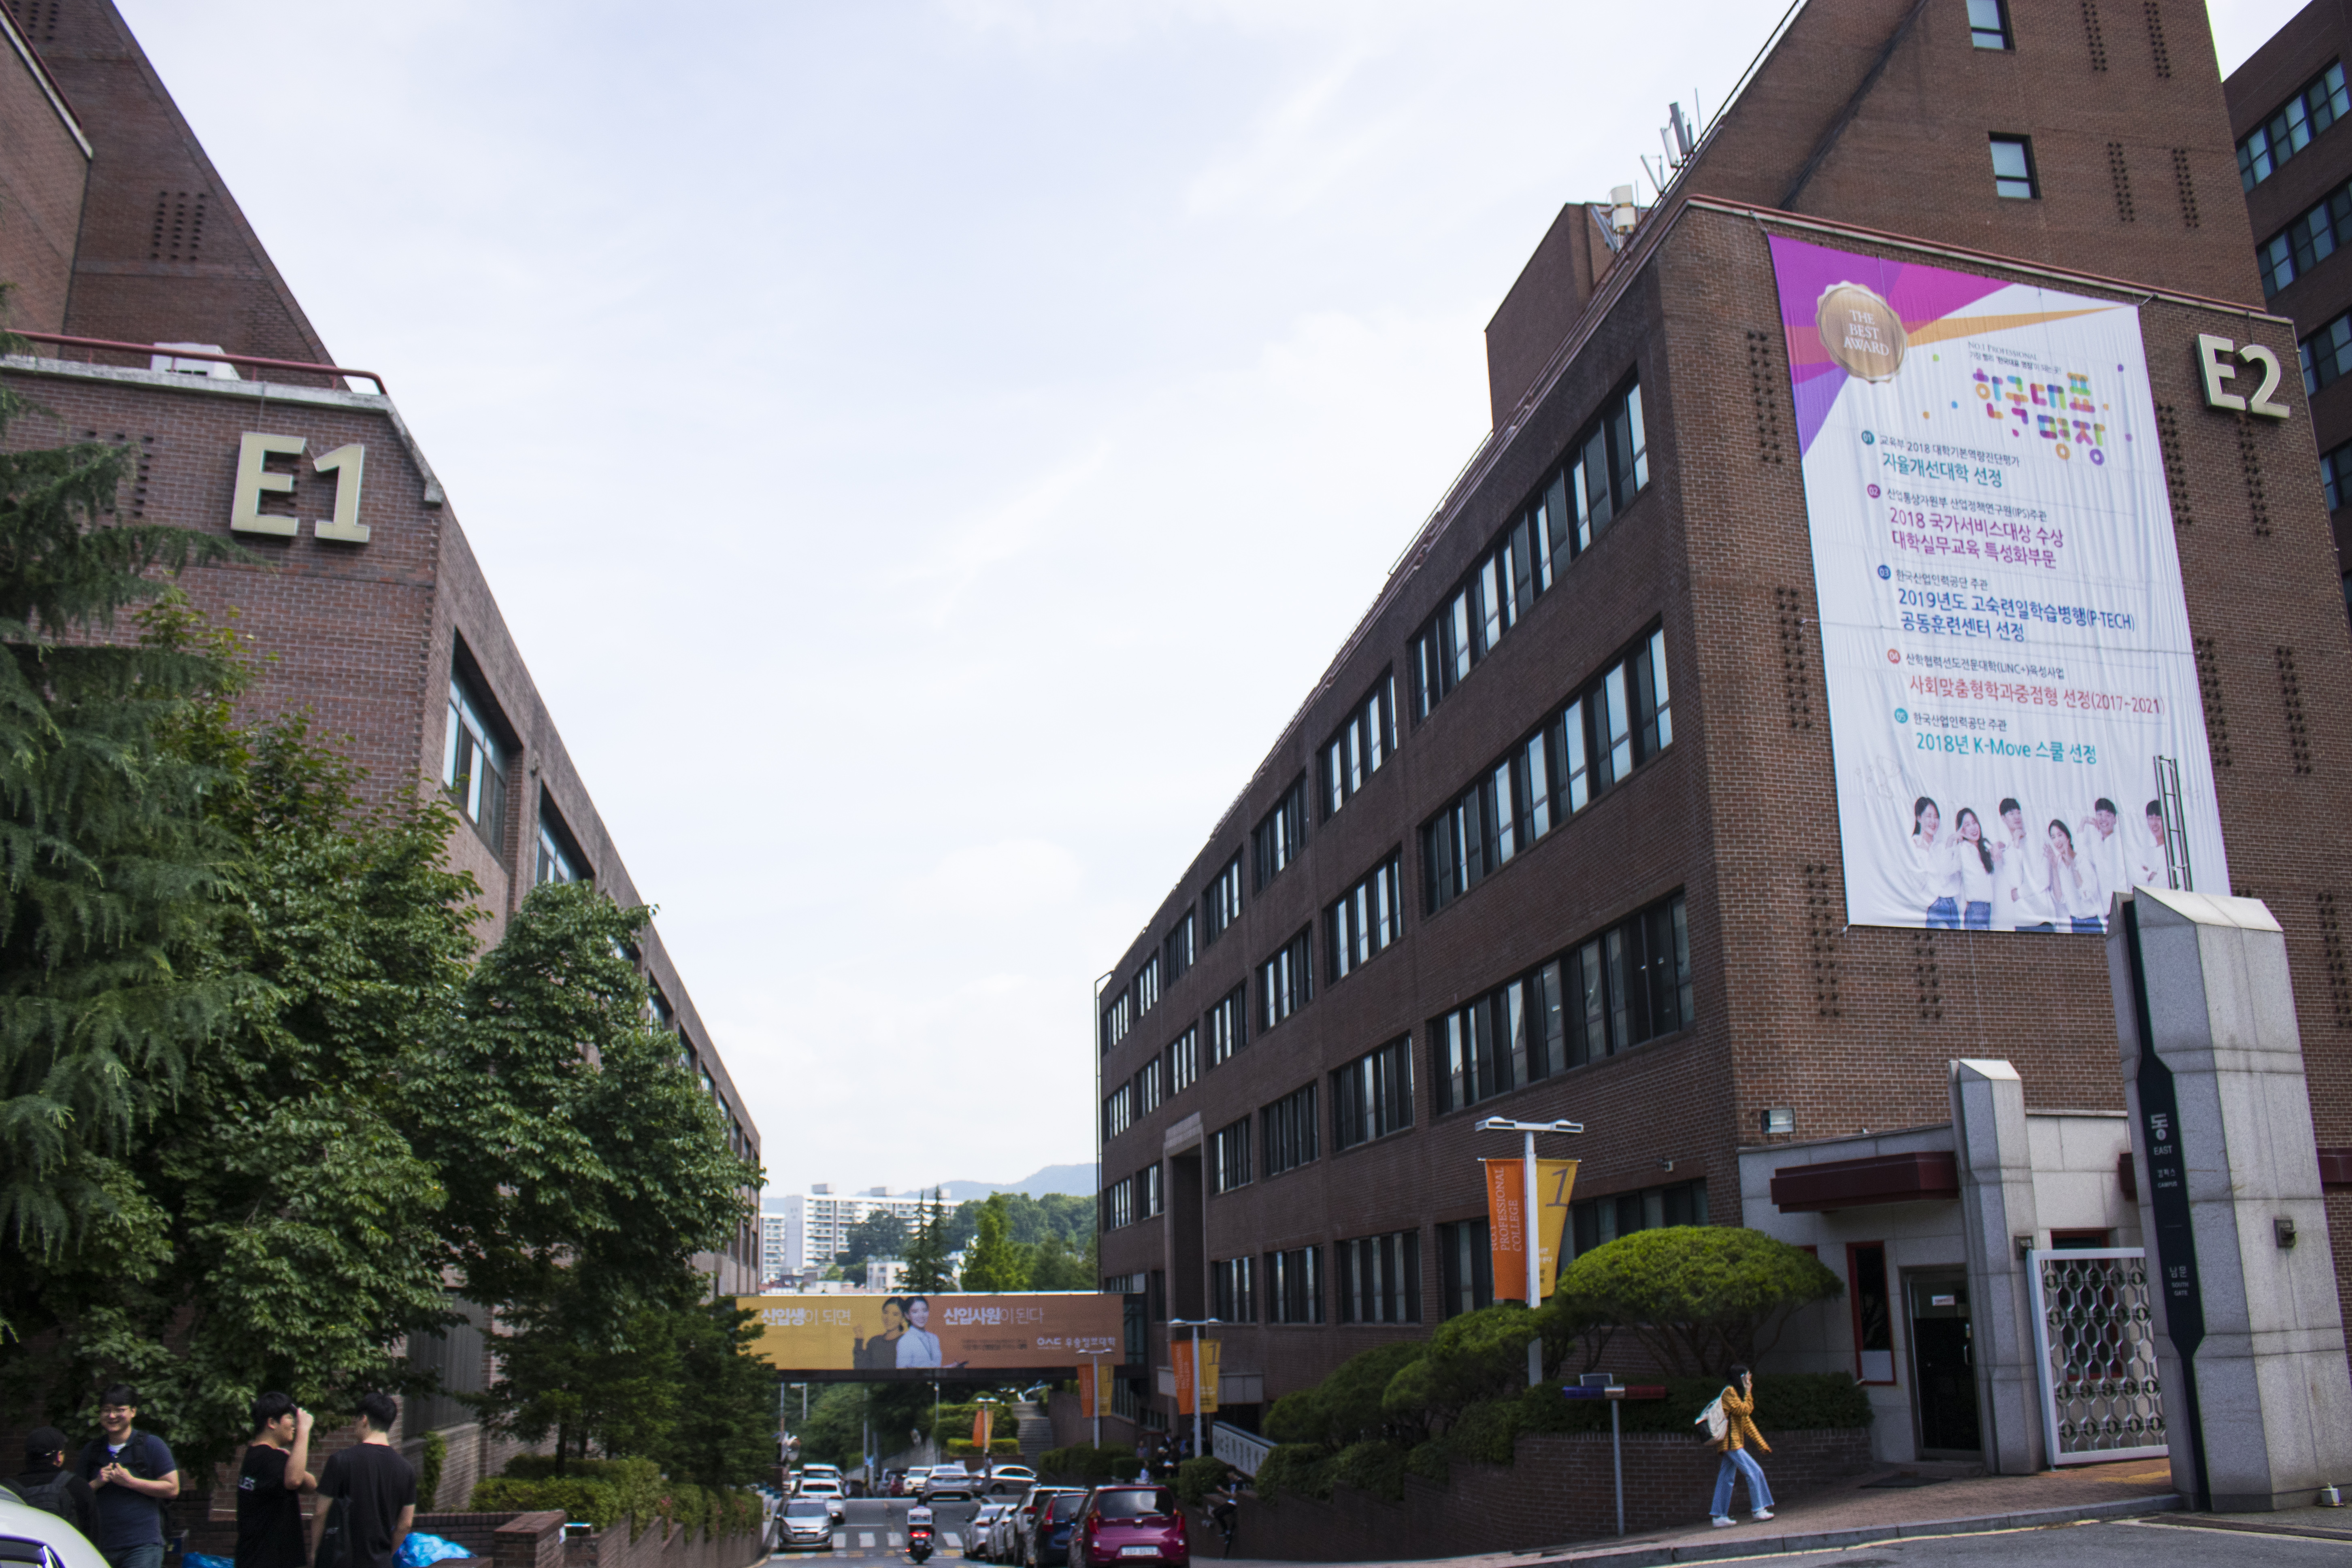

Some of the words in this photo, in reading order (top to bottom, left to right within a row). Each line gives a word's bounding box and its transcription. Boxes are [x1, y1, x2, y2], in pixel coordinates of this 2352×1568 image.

[1849, 309, 1875, 325] THE
[1849, 323, 1879, 339] BEST
[1844, 336, 1889, 356] AWARD
[2196, 333, 2290, 419] E2
[1973, 368, 2096, 425] 한국대표
[1880, 435, 1904, 449] 교육부
[1907, 441, 1931, 453] 2018
[1933, 444, 2020, 468] 대학기본역량진단평가
[2037, 415, 2105, 466] 명장
[1883, 452, 1969, 483] 자율개선대학
[1974, 466, 2002, 488] 선정
[231, 432, 370, 543] E1
[1887, 488, 1948, 508] 산업통상자원부
[1951, 498, 2048, 522] 산업정책연구원(IPS)주관
[1890, 507, 1926, 529] 2018
[1929, 513, 2031, 543] 국가서비스대상
[2036, 527, 2064, 548] 수상
[1892, 530, 1980, 559] 대학실무교육
[1985, 542, 2056, 569] 특성화부문
[1896, 568, 1968, 589] 한국산업인력공단
[1971, 578, 1988, 591] 주관
[1898, 588, 1967, 611] 2019년도
[1971, 595, 2135, 632] 고숙련일학습병행(P-TECH)
[1901, 611, 1991, 638] 공동훈련센터
[1996, 621, 2025, 643] 선정
[1910, 675, 2058, 707] 사회맞춤형학과중점형
[1914, 712, 1986, 730] 한국산업인력공단
[1988, 719, 2007, 732] 주관
[1916, 732, 1970, 755] 2018년
[1974, 737, 2031, 757] K-Move
[2036, 741, 2065, 762] 스쿨
[2069, 744, 2097, 765] 선정
[2150, 1113, 2169, 1141] 동
[2154, 1145, 2173, 1155] EAST
[1495, 1167, 1510, 1251] PROFESSIONAL
[1508, 1200, 1522, 1252] COLLEGE
[2169, 1266, 2187, 1279] 남문
[761, 1308, 818, 1326] 신입생이
[823, 1308, 850, 1325] 되면
